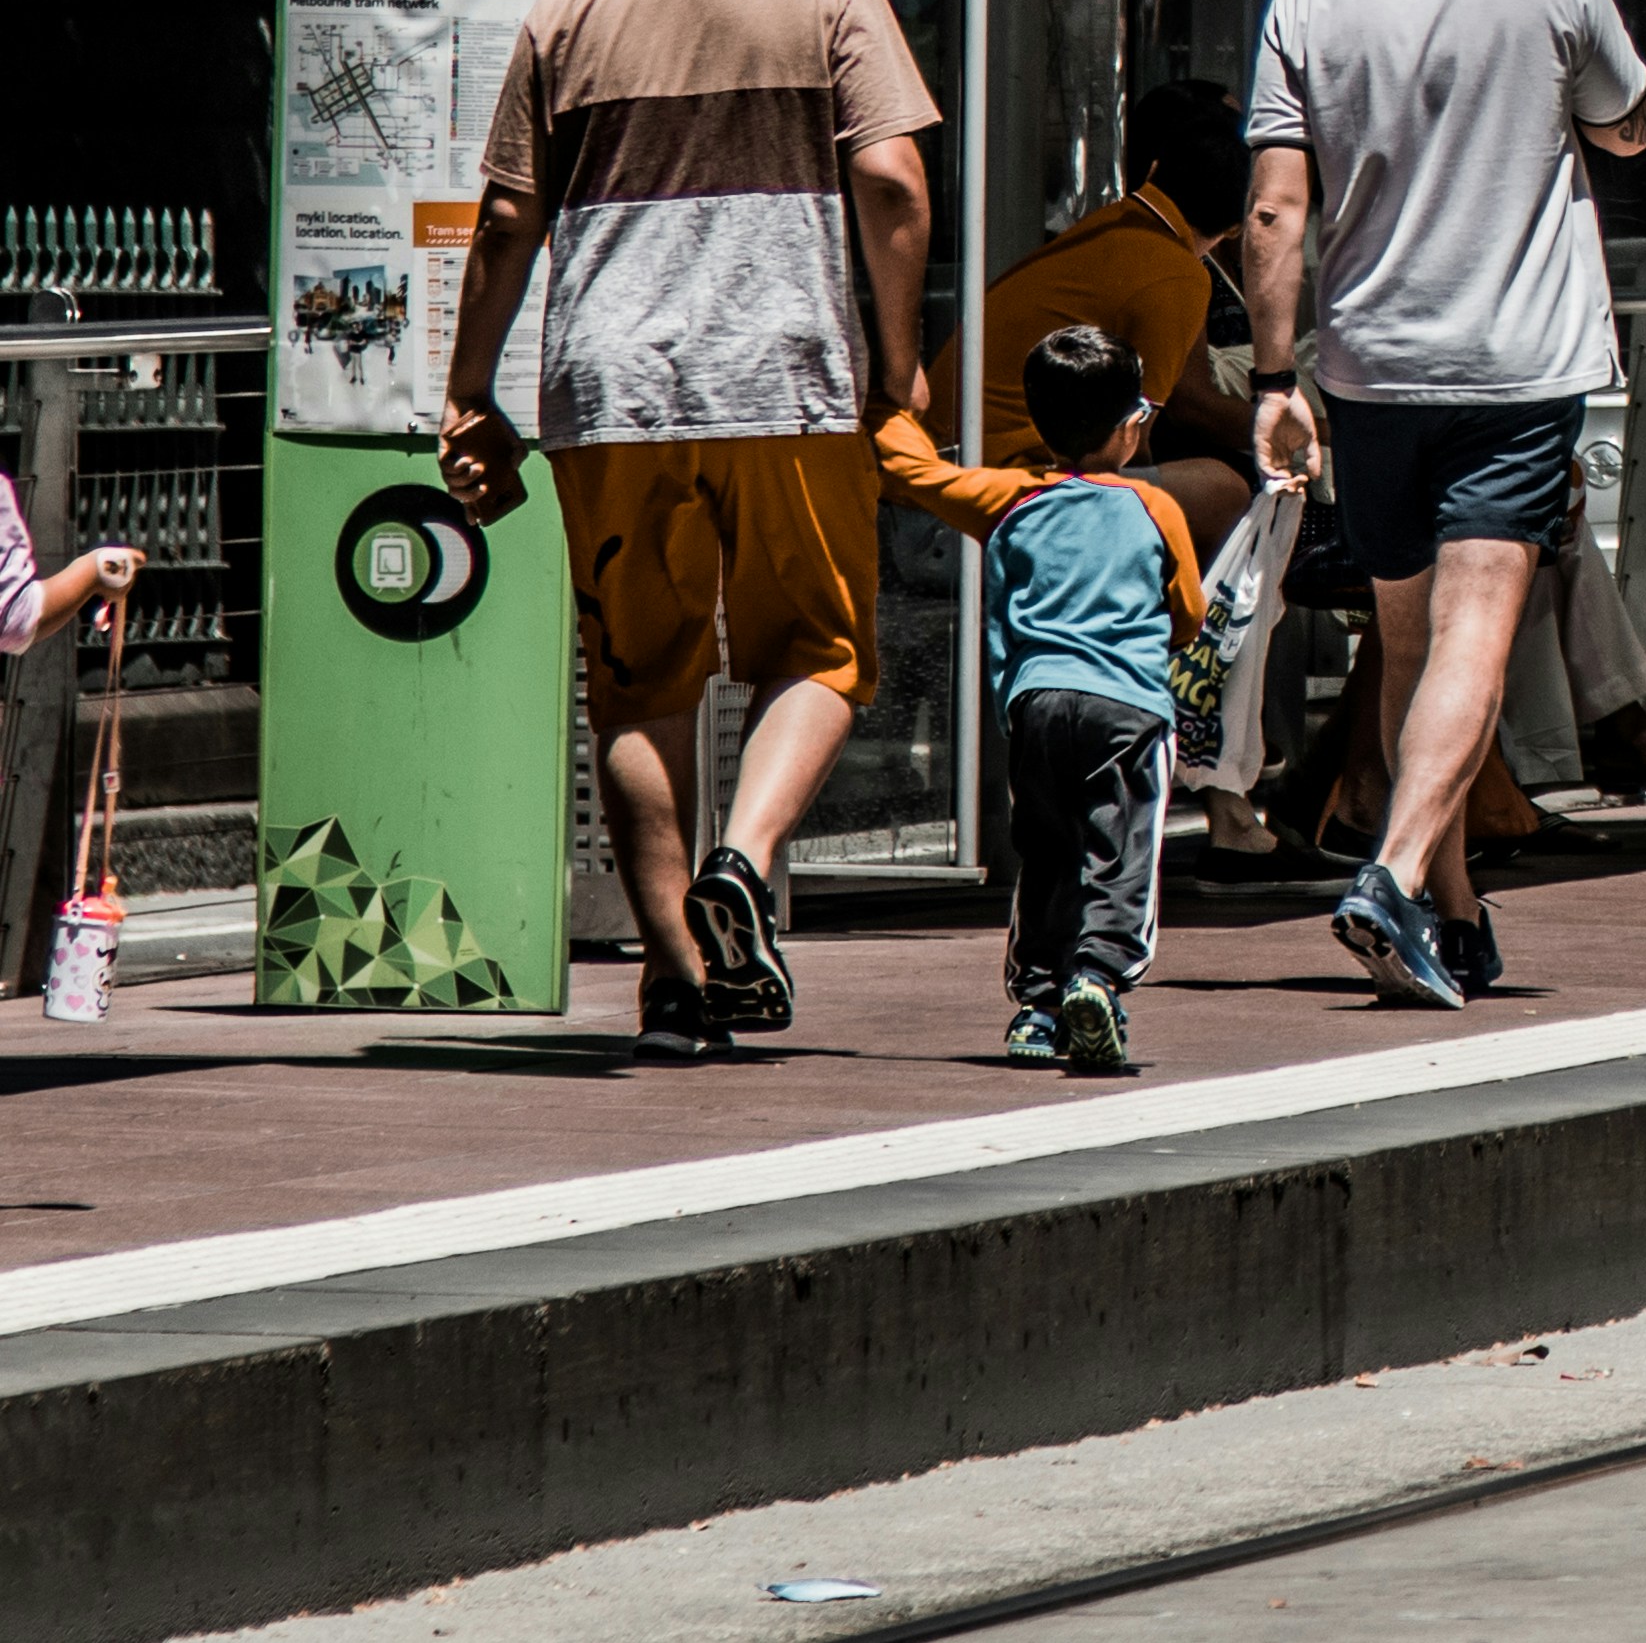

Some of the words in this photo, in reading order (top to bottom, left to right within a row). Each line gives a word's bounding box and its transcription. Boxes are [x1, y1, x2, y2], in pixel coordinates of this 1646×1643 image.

[296, 211, 326, 225] myki
[327, 211, 382, 225] location,
[295, 225, 347, 240] location,
[349, 226, 405, 240] location.
[425, 224, 456, 237] Tram
